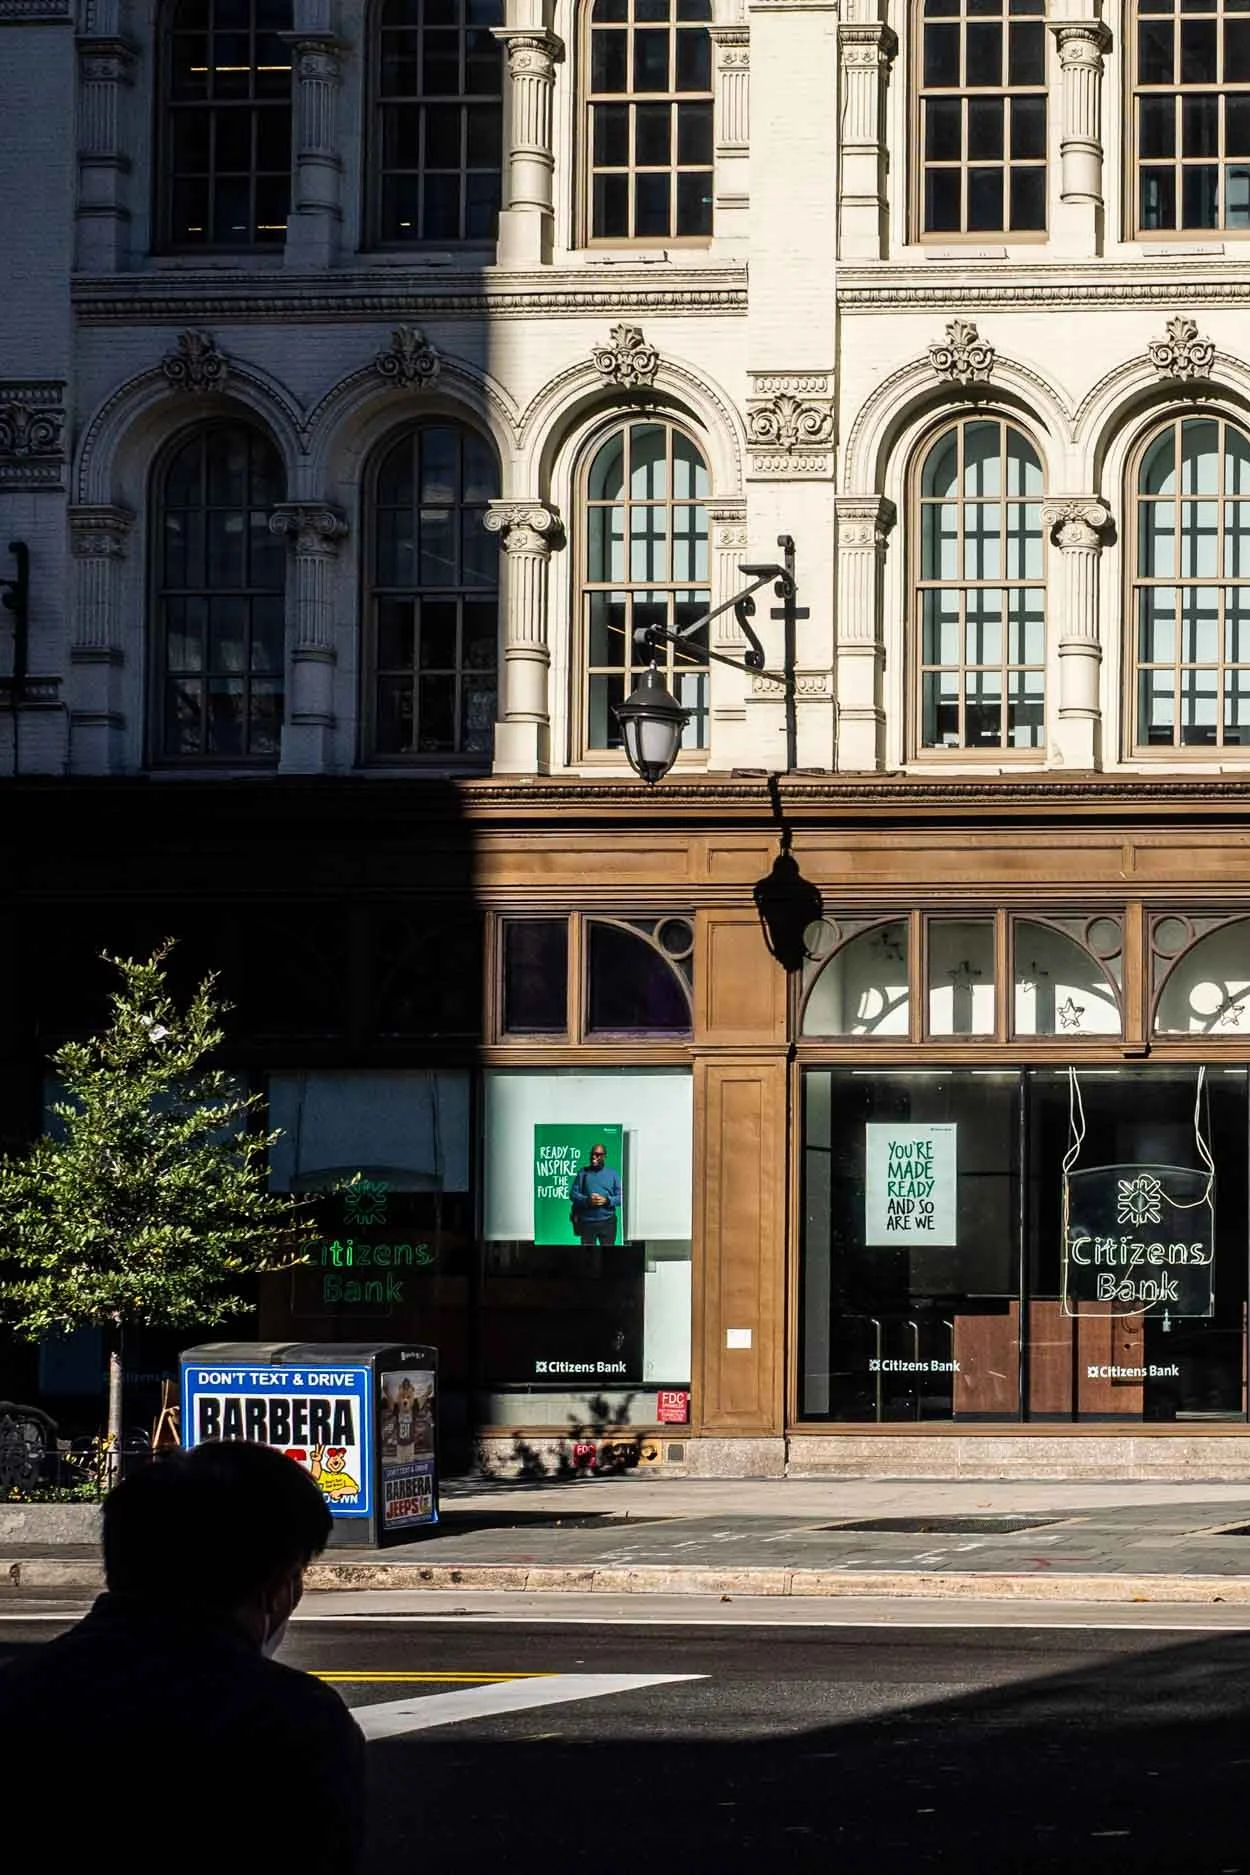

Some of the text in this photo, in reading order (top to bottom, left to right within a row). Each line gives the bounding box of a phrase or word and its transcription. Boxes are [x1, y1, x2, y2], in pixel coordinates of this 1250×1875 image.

[540, 1146, 580, 1160] READY TO
[888, 1141, 934, 1160] YOU'RE
[537, 1160, 577, 1176] INSPIRE
[888, 1160, 934, 1180] MADE
[553, 1176, 568, 1186] THE
[888, 1180, 935, 1198] READY
[537, 1186, 569, 1200] FUTURE
[887, 1198, 934, 1215] AND SO
[887, 1215, 935, 1231] ARE WE
[302, 1240, 430, 1267] Citizens
[1072, 1237, 1205, 1265] Citizens
[323, 1272, 403, 1302] Bank
[1097, 1271, 1179, 1301] Bank
[549, 1361, 626, 1373] Citizens Bank
[882, 1359, 960, 1371] Citizens Bank
[1100, 1364, 1179, 1377] Citizens Bank
[198, 1372, 354, 1387] DON'T TEXT & DRIVE
[662, 1392, 685, 1404] FDC
[199, 1397, 355, 1446] BARBERA
[385, 1476, 432, 1502] BARBERA
[323, 1493, 358, 1504] DWN
[386, 1498, 419, 1519] JEEPS
